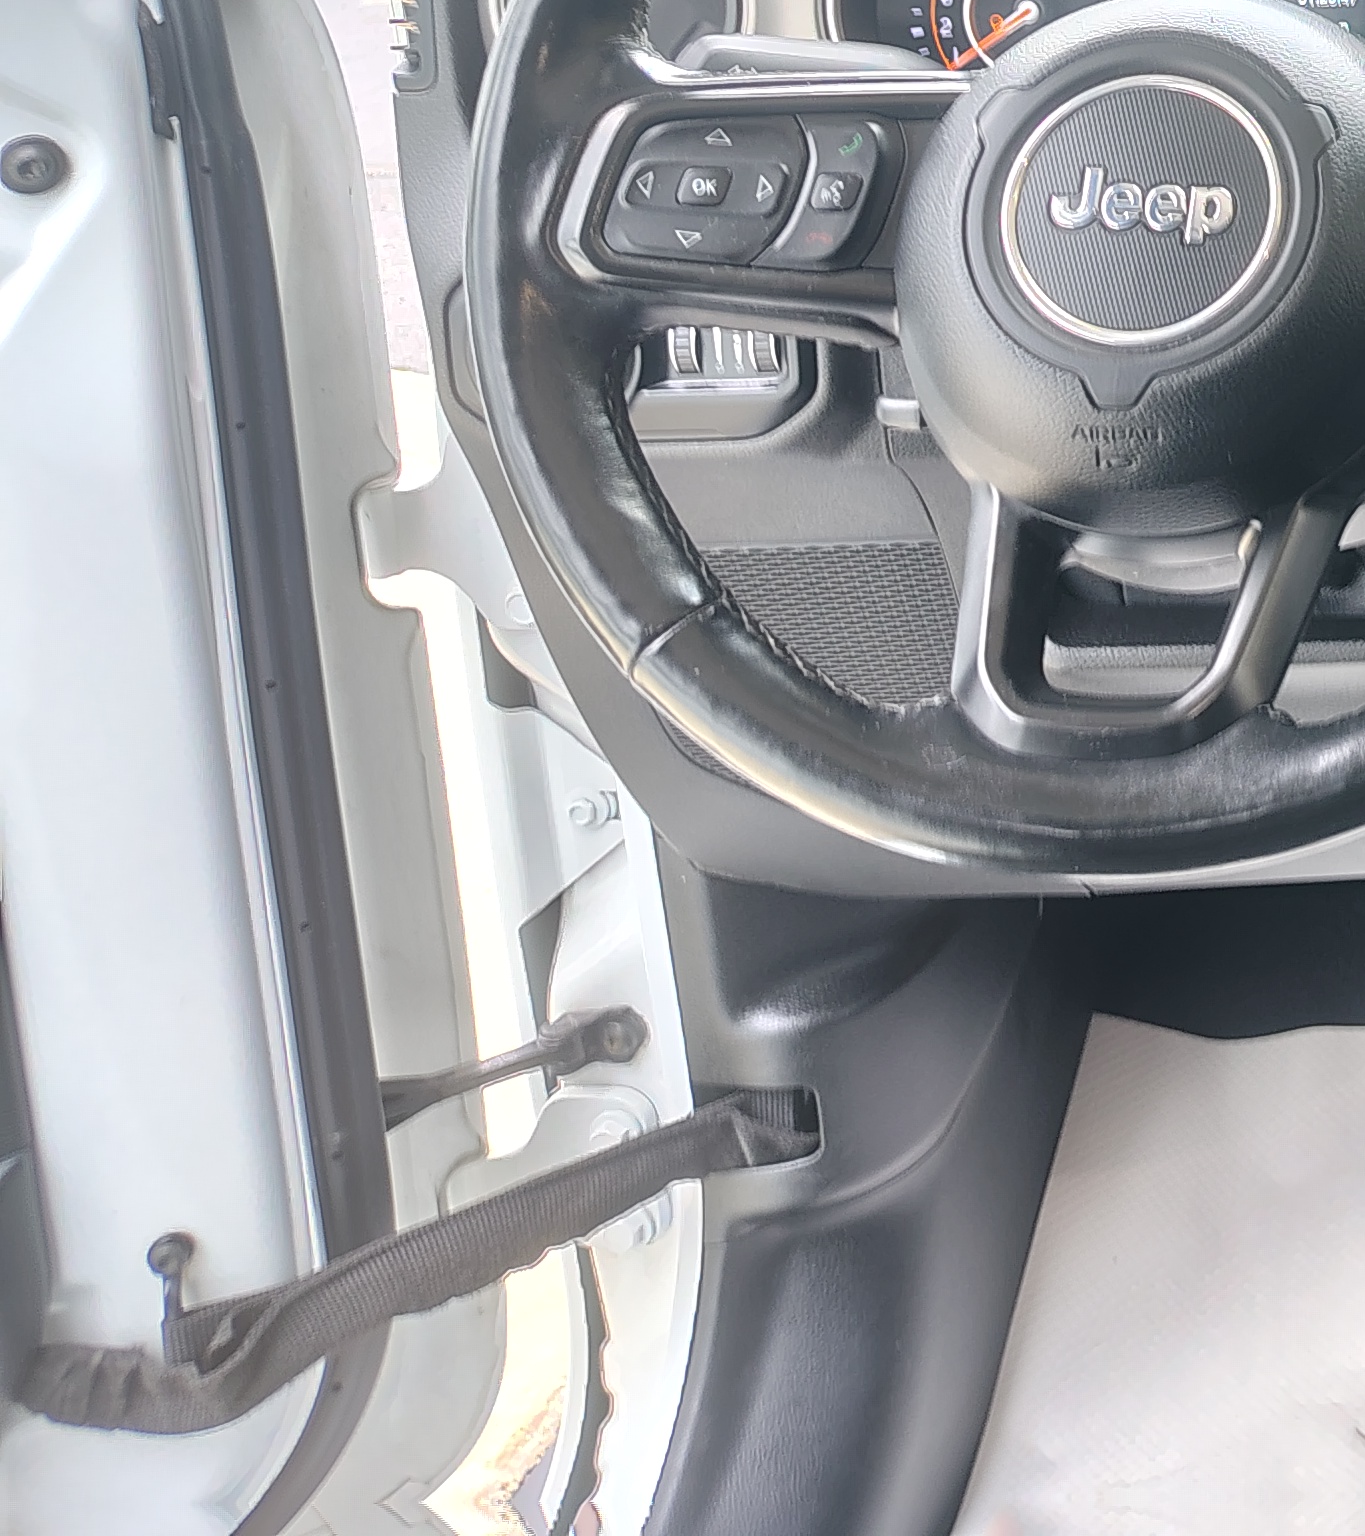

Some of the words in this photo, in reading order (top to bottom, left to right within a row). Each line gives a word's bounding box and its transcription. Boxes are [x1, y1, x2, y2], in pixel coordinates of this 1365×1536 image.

[938, 16, 954, 38] 2
[691, 177, 717, 198] OK
[1050, 166, 1236, 245] Jeep
